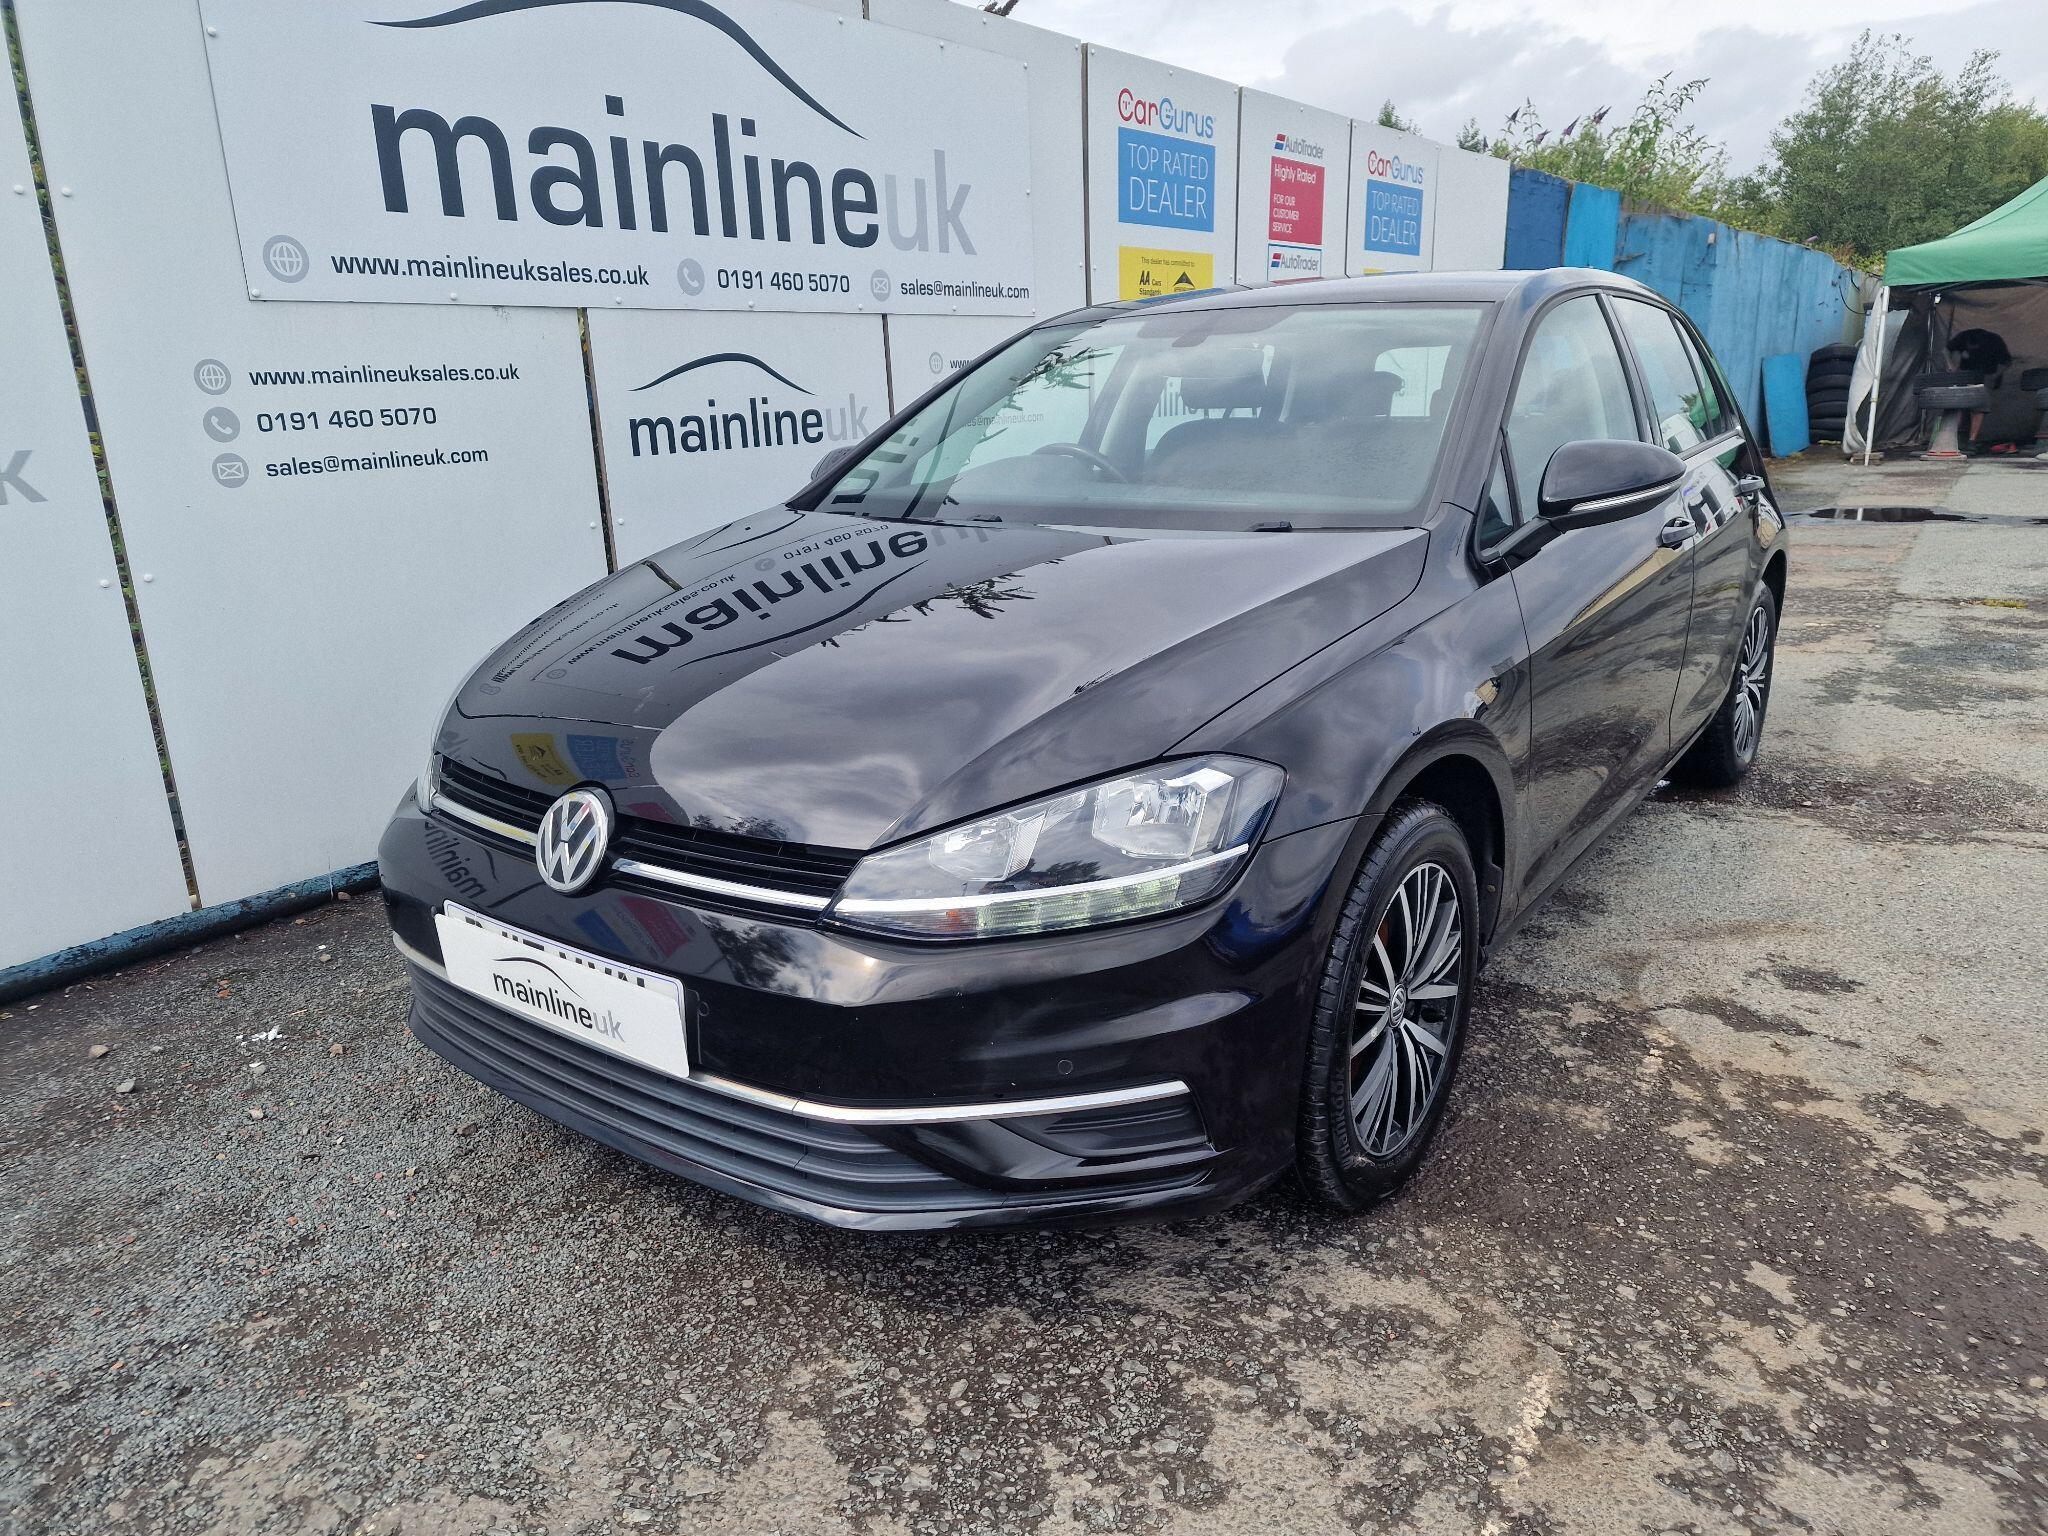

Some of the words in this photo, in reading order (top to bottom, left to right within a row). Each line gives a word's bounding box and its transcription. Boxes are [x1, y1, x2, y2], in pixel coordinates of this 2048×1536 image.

[1118, 88, 1214, 139] CarGurus
[1127, 142, 1159, 171] TOP
[1163, 149, 1209, 180] RATED
[1284, 136, 1325, 159] AutoTrader
[371, 95, 978, 256] mainlineuk
[1274, 164, 1296, 183] Highly
[1297, 168, 1317, 184] Rated
[1368, 150, 1423, 184] CarGurus
[1129, 176, 1207, 219] DEALER
[1273, 193, 1284, 205] FOR
[1371, 190, 1391, 211] TOP
[1392, 193, 1418, 216] RATED
[1370, 215, 1417, 245] DEALER
[331, 254, 650, 287] www.mainlineuksales.co.uk
[1280, 254, 1319, 272] AutoTrader
[717, 268, 764, 291] 0191
[770, 271, 804, 292] 460
[808, 273, 850, 294] 5070
[900, 279, 1030, 300] sales@mainlineuk.com
[1139, 270, 1151, 286] AA
[249, 363, 520, 388] www.mainlineuksales.co.uk
[257, 410, 320, 433] 0191
[328, 409, 374, 430] 460
[380, 407, 437, 428] 5070
[629, 393, 871, 457] mainlineuk
[265, 447, 489, 478] sales@mainlineuk.com
[493, 972, 626, 1043] mainlineuk
